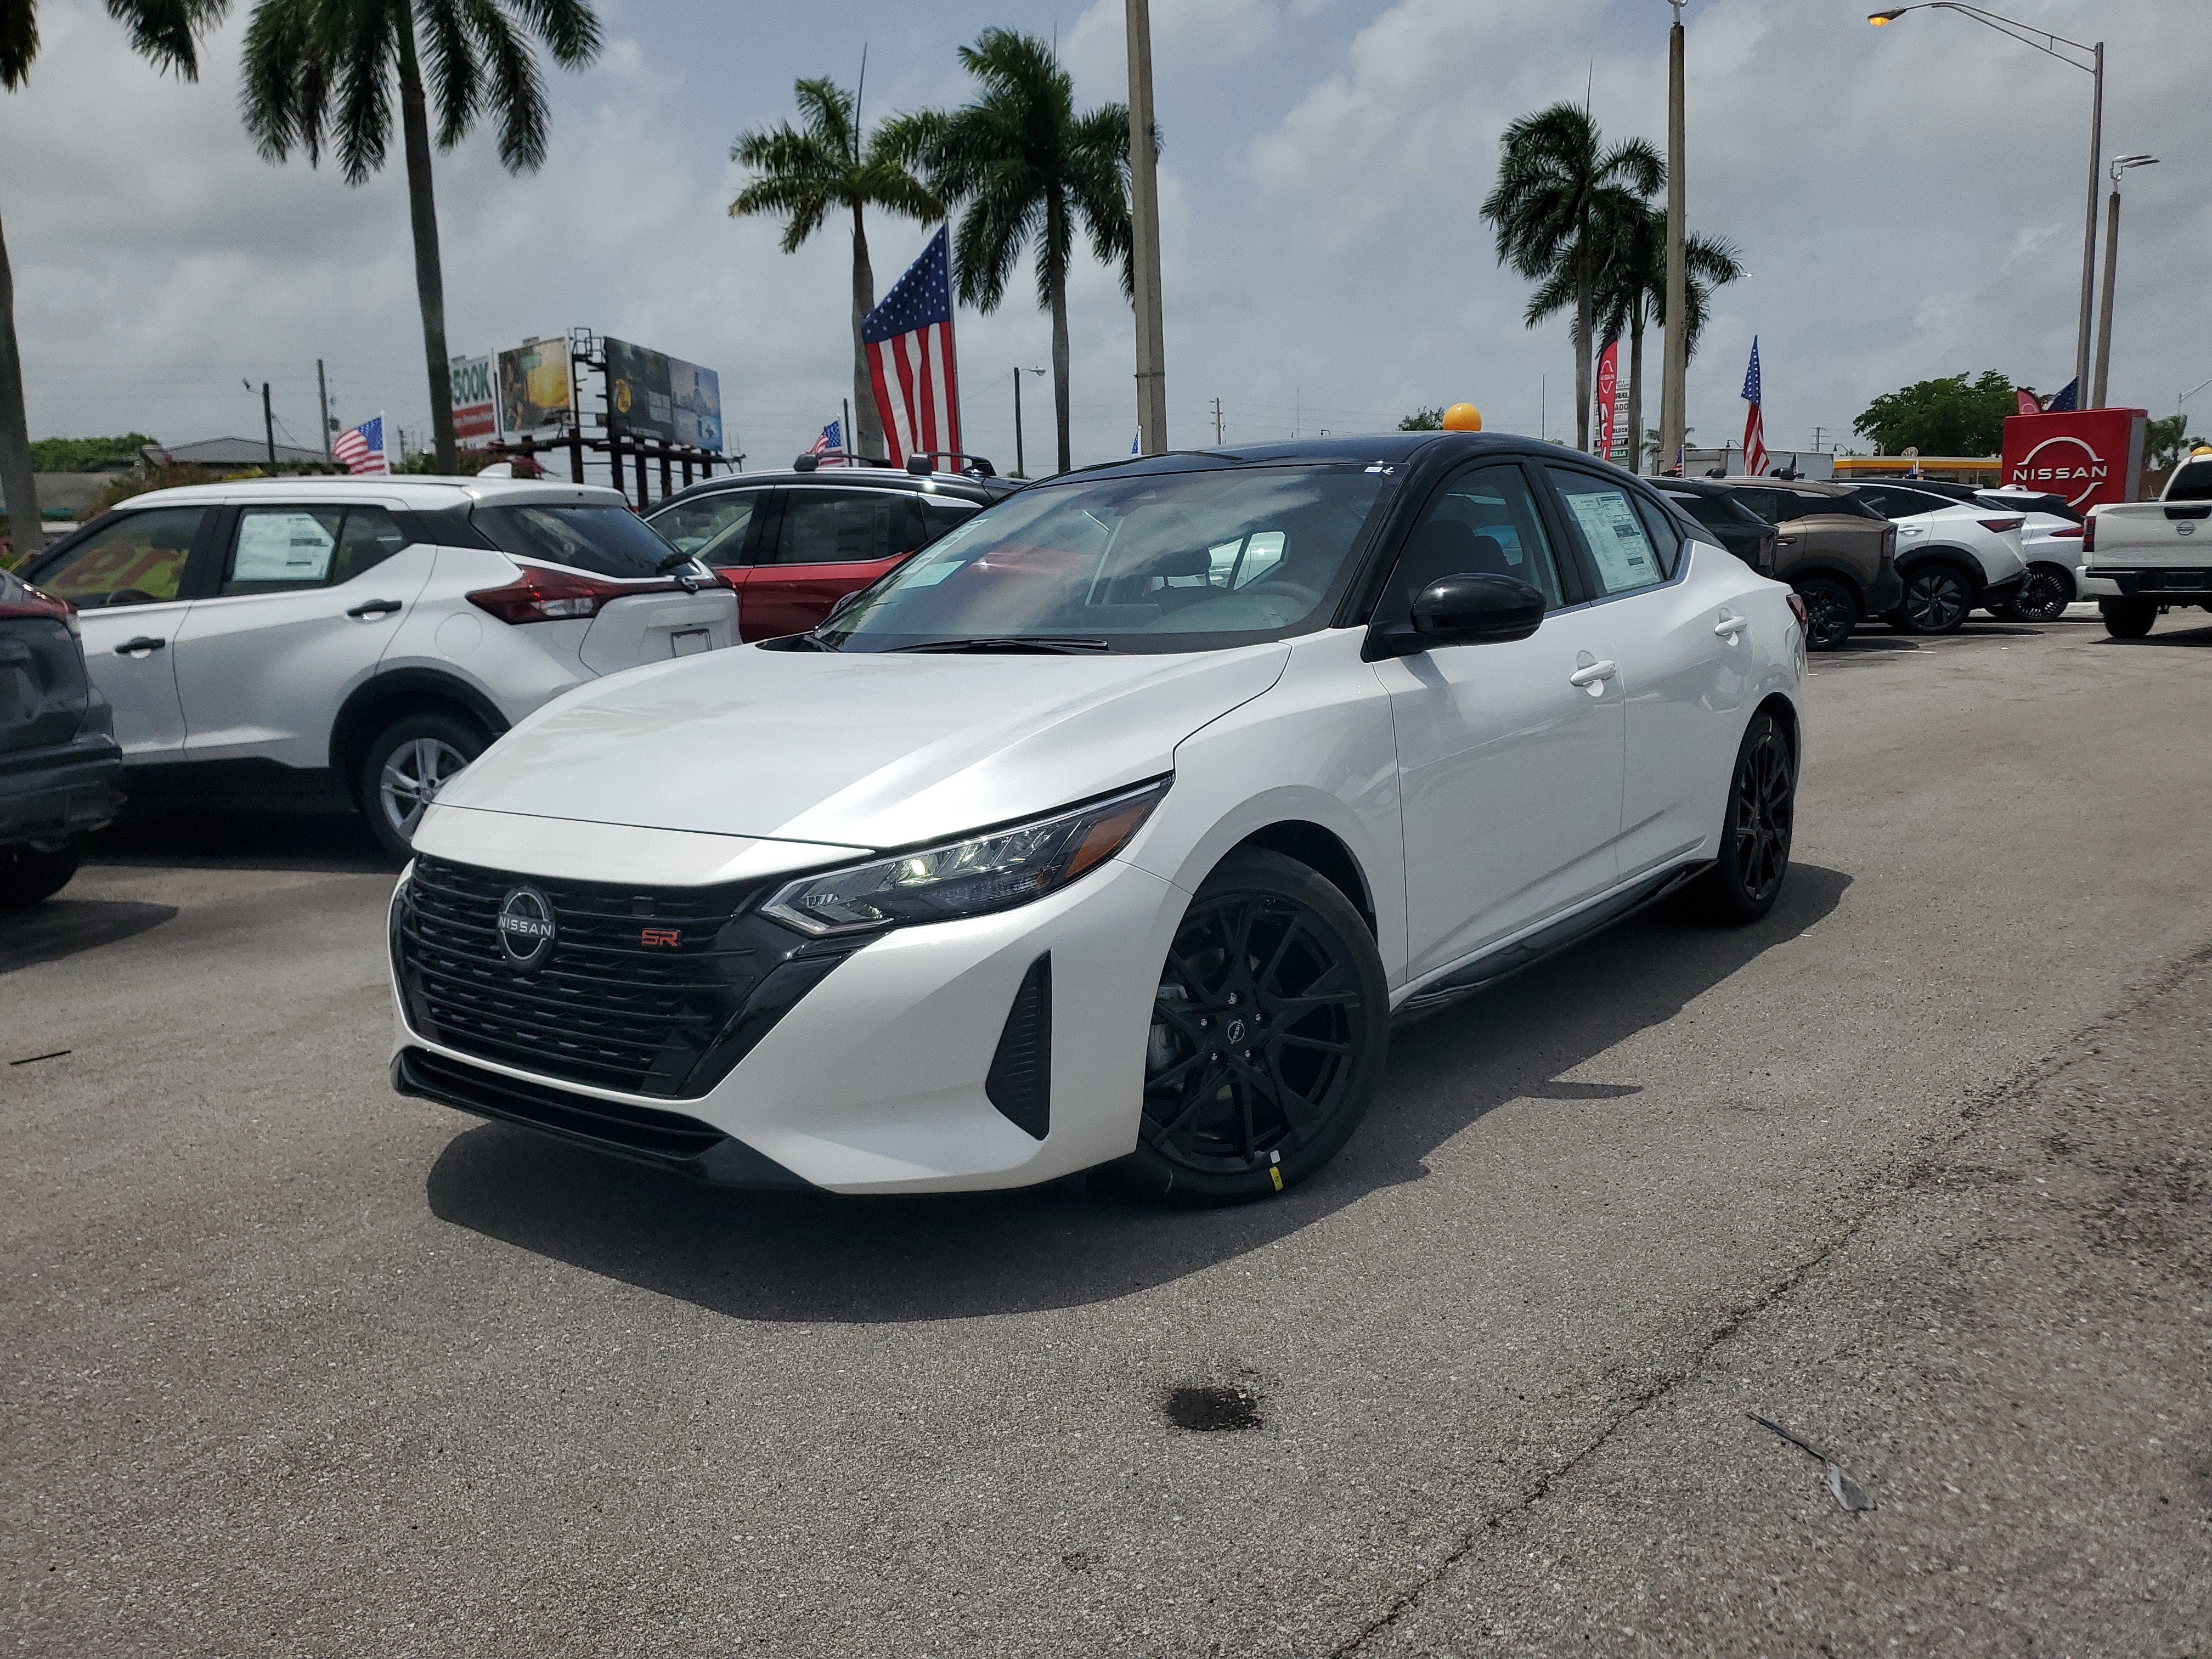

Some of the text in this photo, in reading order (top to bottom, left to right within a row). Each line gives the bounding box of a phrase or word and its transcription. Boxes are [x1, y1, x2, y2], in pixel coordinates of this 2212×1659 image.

[2013, 466, 2107, 481] NISSAN
[499, 915, 551, 936] NISSAN
[641, 929, 678, 946] SR
